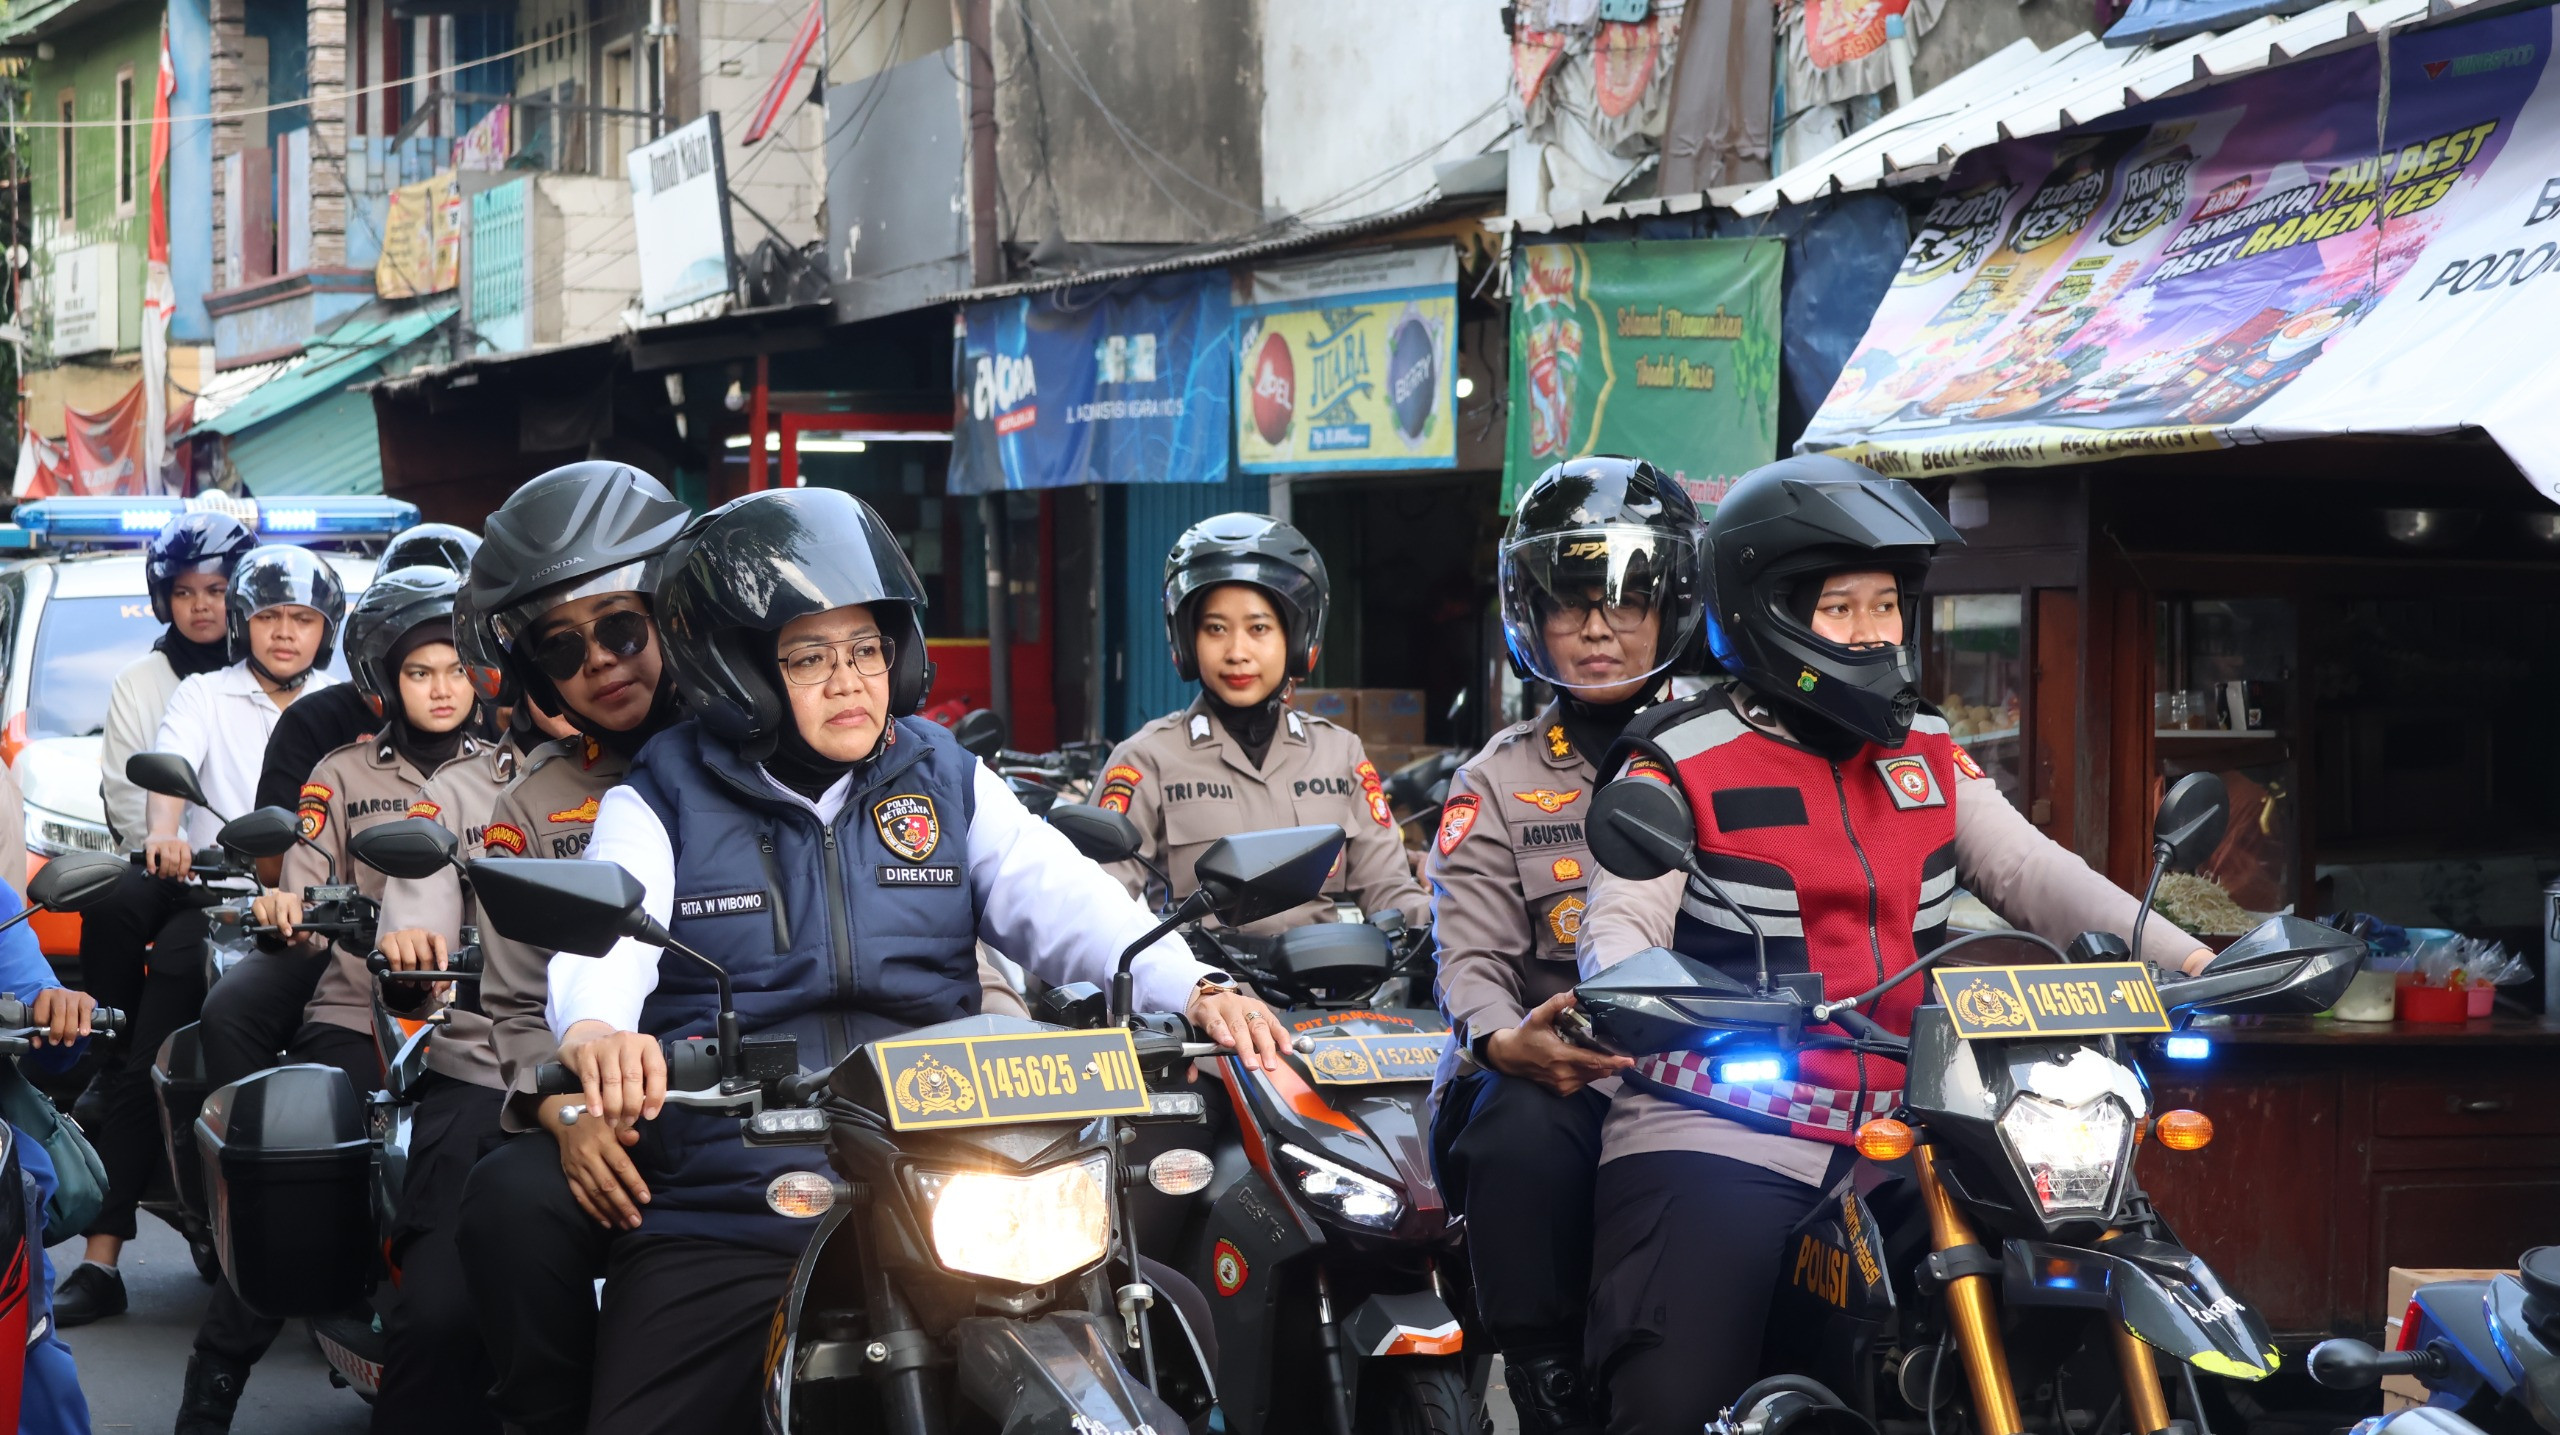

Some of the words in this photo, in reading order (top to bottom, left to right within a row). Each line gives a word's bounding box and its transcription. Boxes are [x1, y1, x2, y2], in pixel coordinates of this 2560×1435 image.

[2315, 154, 2394, 207] THE
[2387, 122, 2496, 183] BEST
[2009, 201, 2080, 247] YES
[2101, 187, 2169, 241] YES
[2235, 197, 2379, 260] RAMEN
[2382, 172, 2461, 220] YES
[1310, 329, 1370, 408] JUARA
[1394, 353, 1433, 404] BERRY
[1921, 444, 1960, 471] BELI
[531, 556, 585, 581] HONDA
[1164, 782, 1193, 802] TRI
[1196, 782, 1233, 799] PUJI
[1294, 778, 1350, 798] POLRI
[881, 806, 907, 823] METRO
[907, 806, 930, 815] JAYA
[887, 798, 916, 810] POLDA
[886, 868, 954, 882] DIREKTUR
[681, 901, 703, 916] RITA
[705, 900, 716, 913] W
[717, 894, 762, 912] WIBOWO
[1294, 1017, 1323, 1032] DIT
[1328, 1010, 1415, 1028] PAMOBVIT
[1793, 1234, 1849, 1309] POLISI
